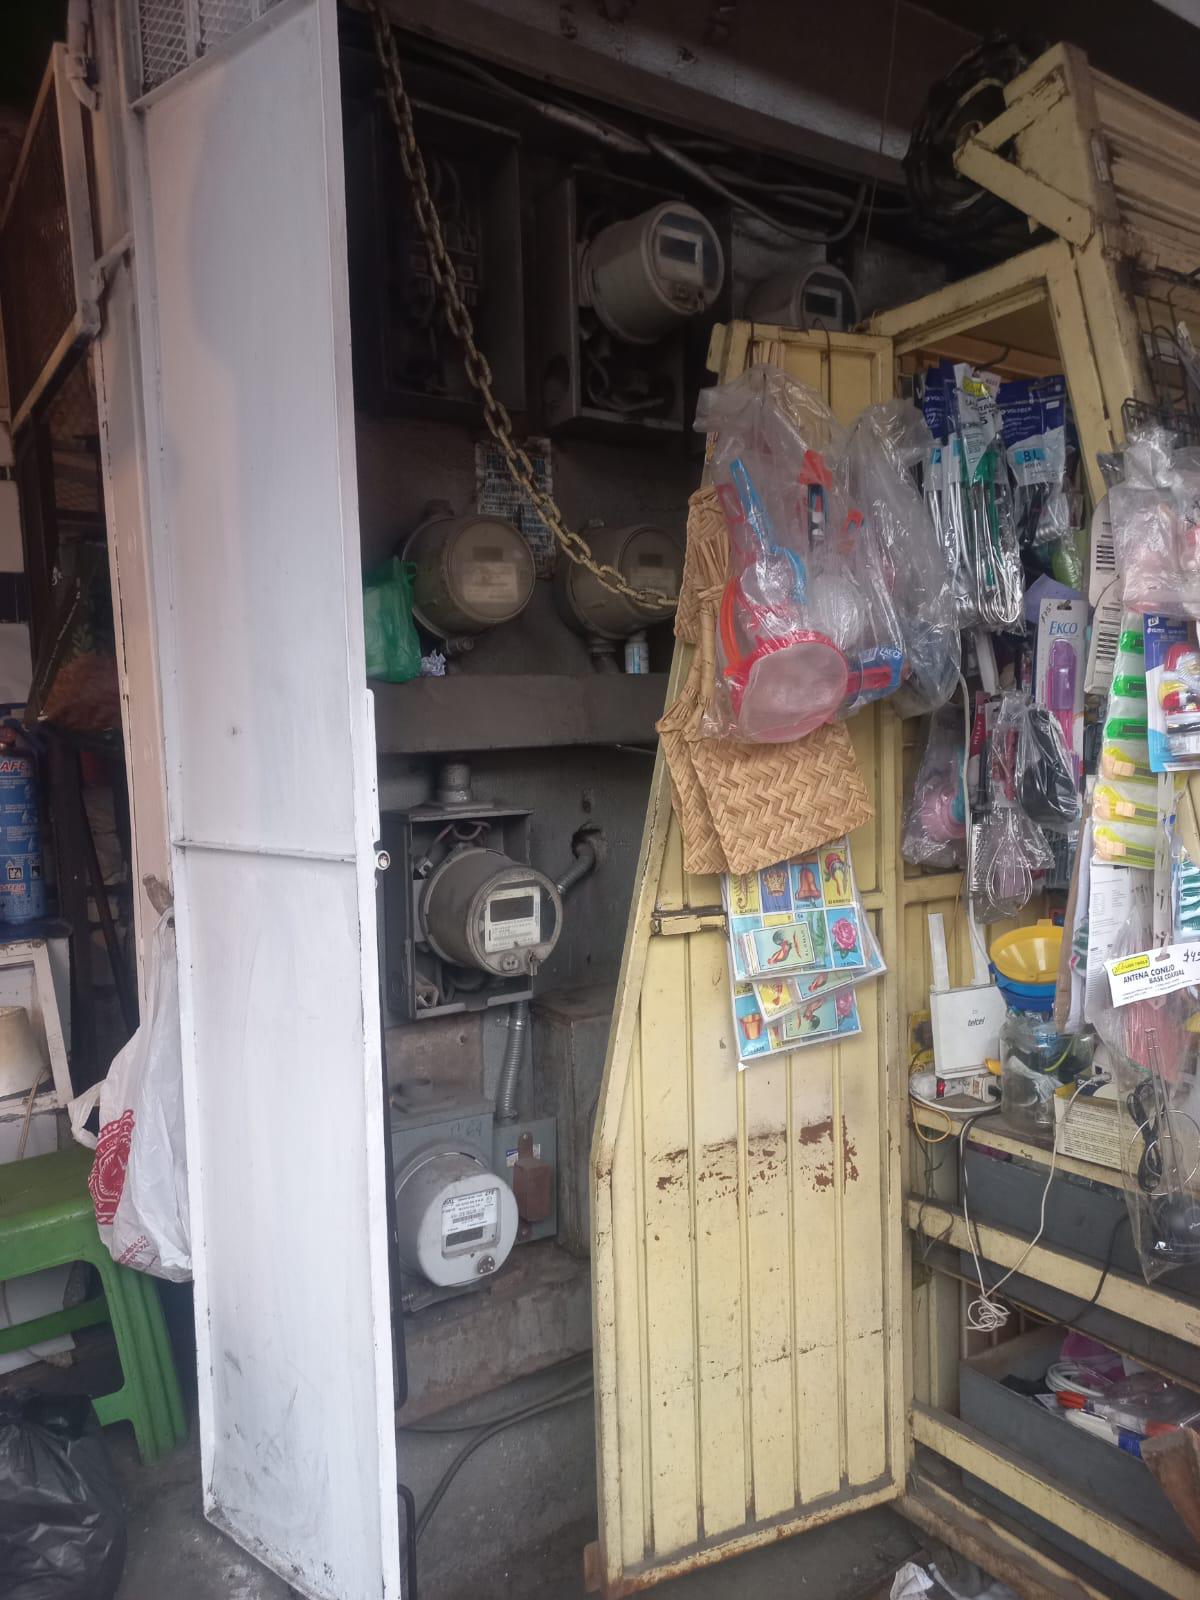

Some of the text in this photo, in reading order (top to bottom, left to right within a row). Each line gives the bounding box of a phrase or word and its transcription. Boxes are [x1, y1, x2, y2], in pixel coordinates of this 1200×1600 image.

[1049, 620, 1079, 635] EKCO
[1123, 971, 1149, 983] ANTENA
[1151, 964, 1174, 976] CONEJO
[1149, 974, 1164, 984] BASE
